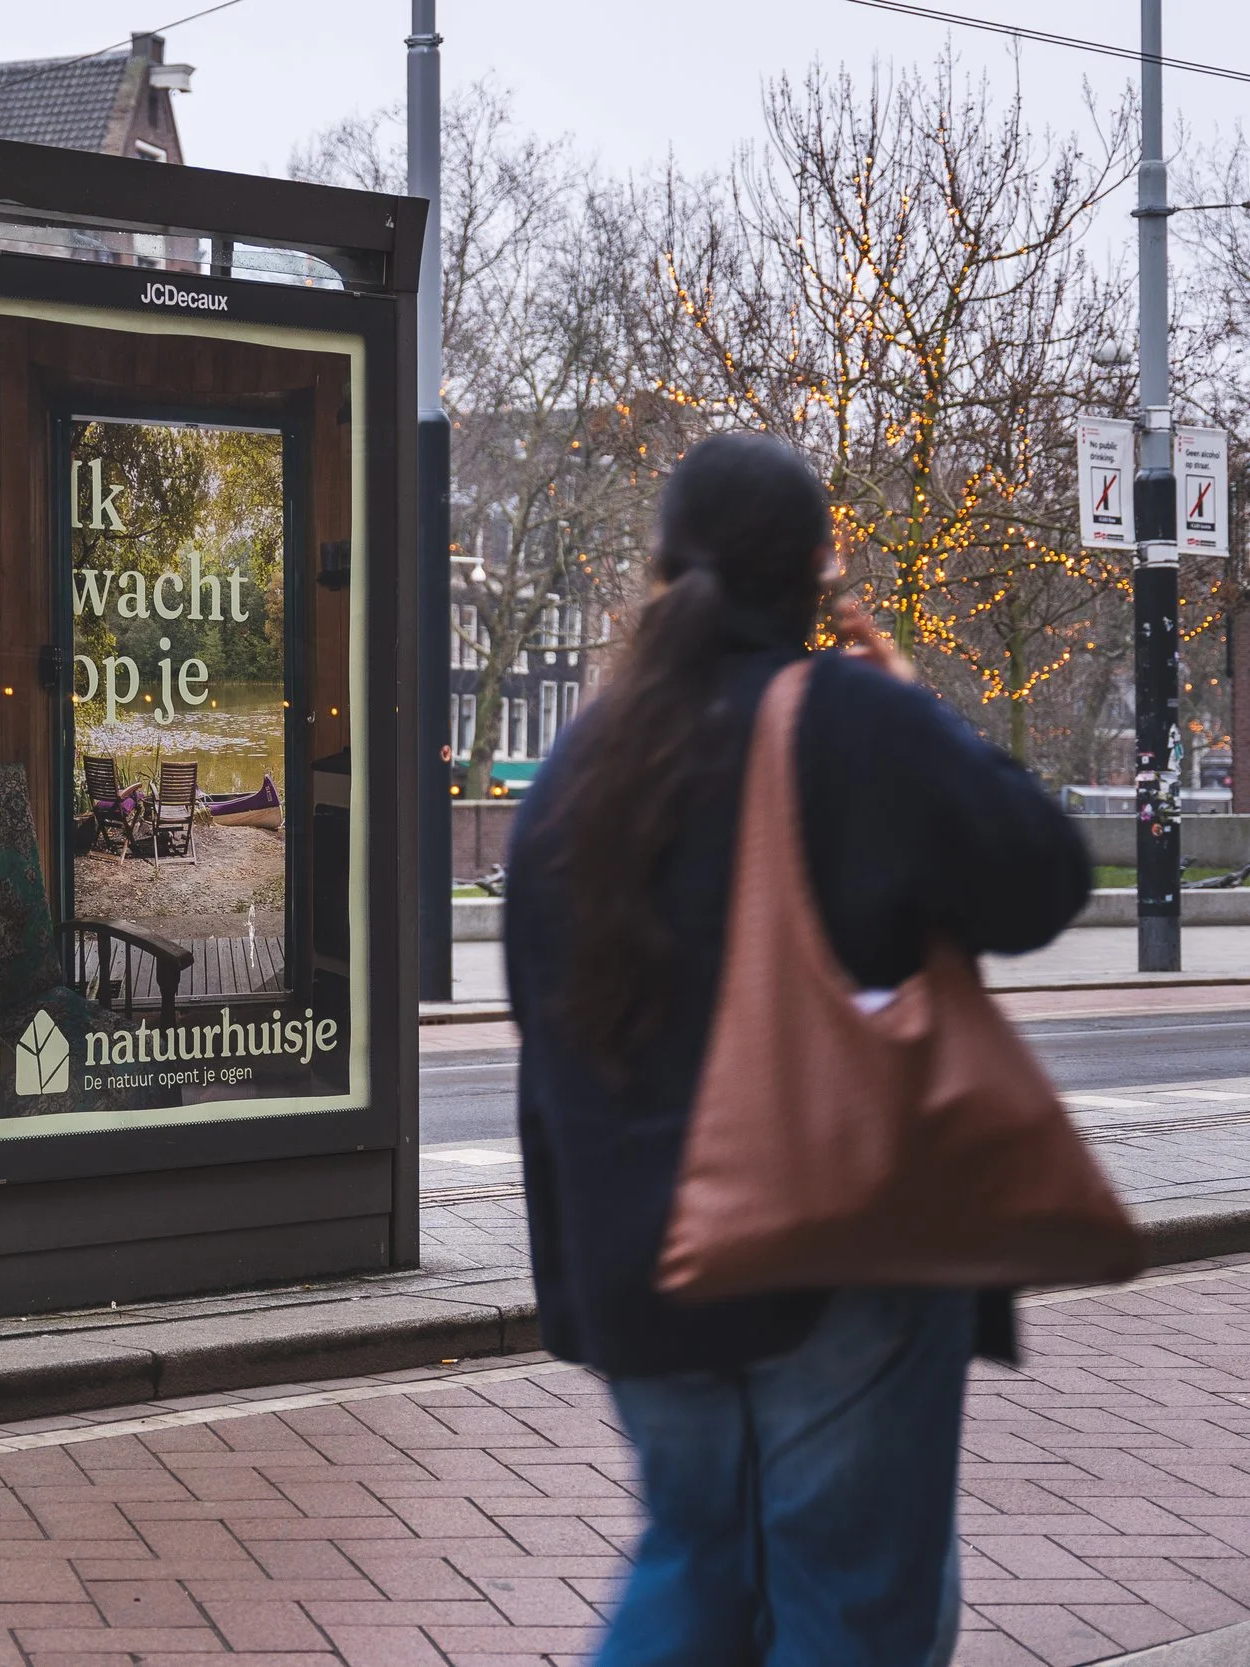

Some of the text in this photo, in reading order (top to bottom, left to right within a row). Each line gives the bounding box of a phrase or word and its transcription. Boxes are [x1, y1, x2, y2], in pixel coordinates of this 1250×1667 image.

[140, 282, 228, 311] JCDecaux
[71, 457, 126, 531] Ik
[73, 551, 249, 622] wacht
[74, 636, 209, 725] op je
[84, 1007, 338, 1066] natuurhuisje
[84, 1066, 253, 1091] De natuur opent je ogen
